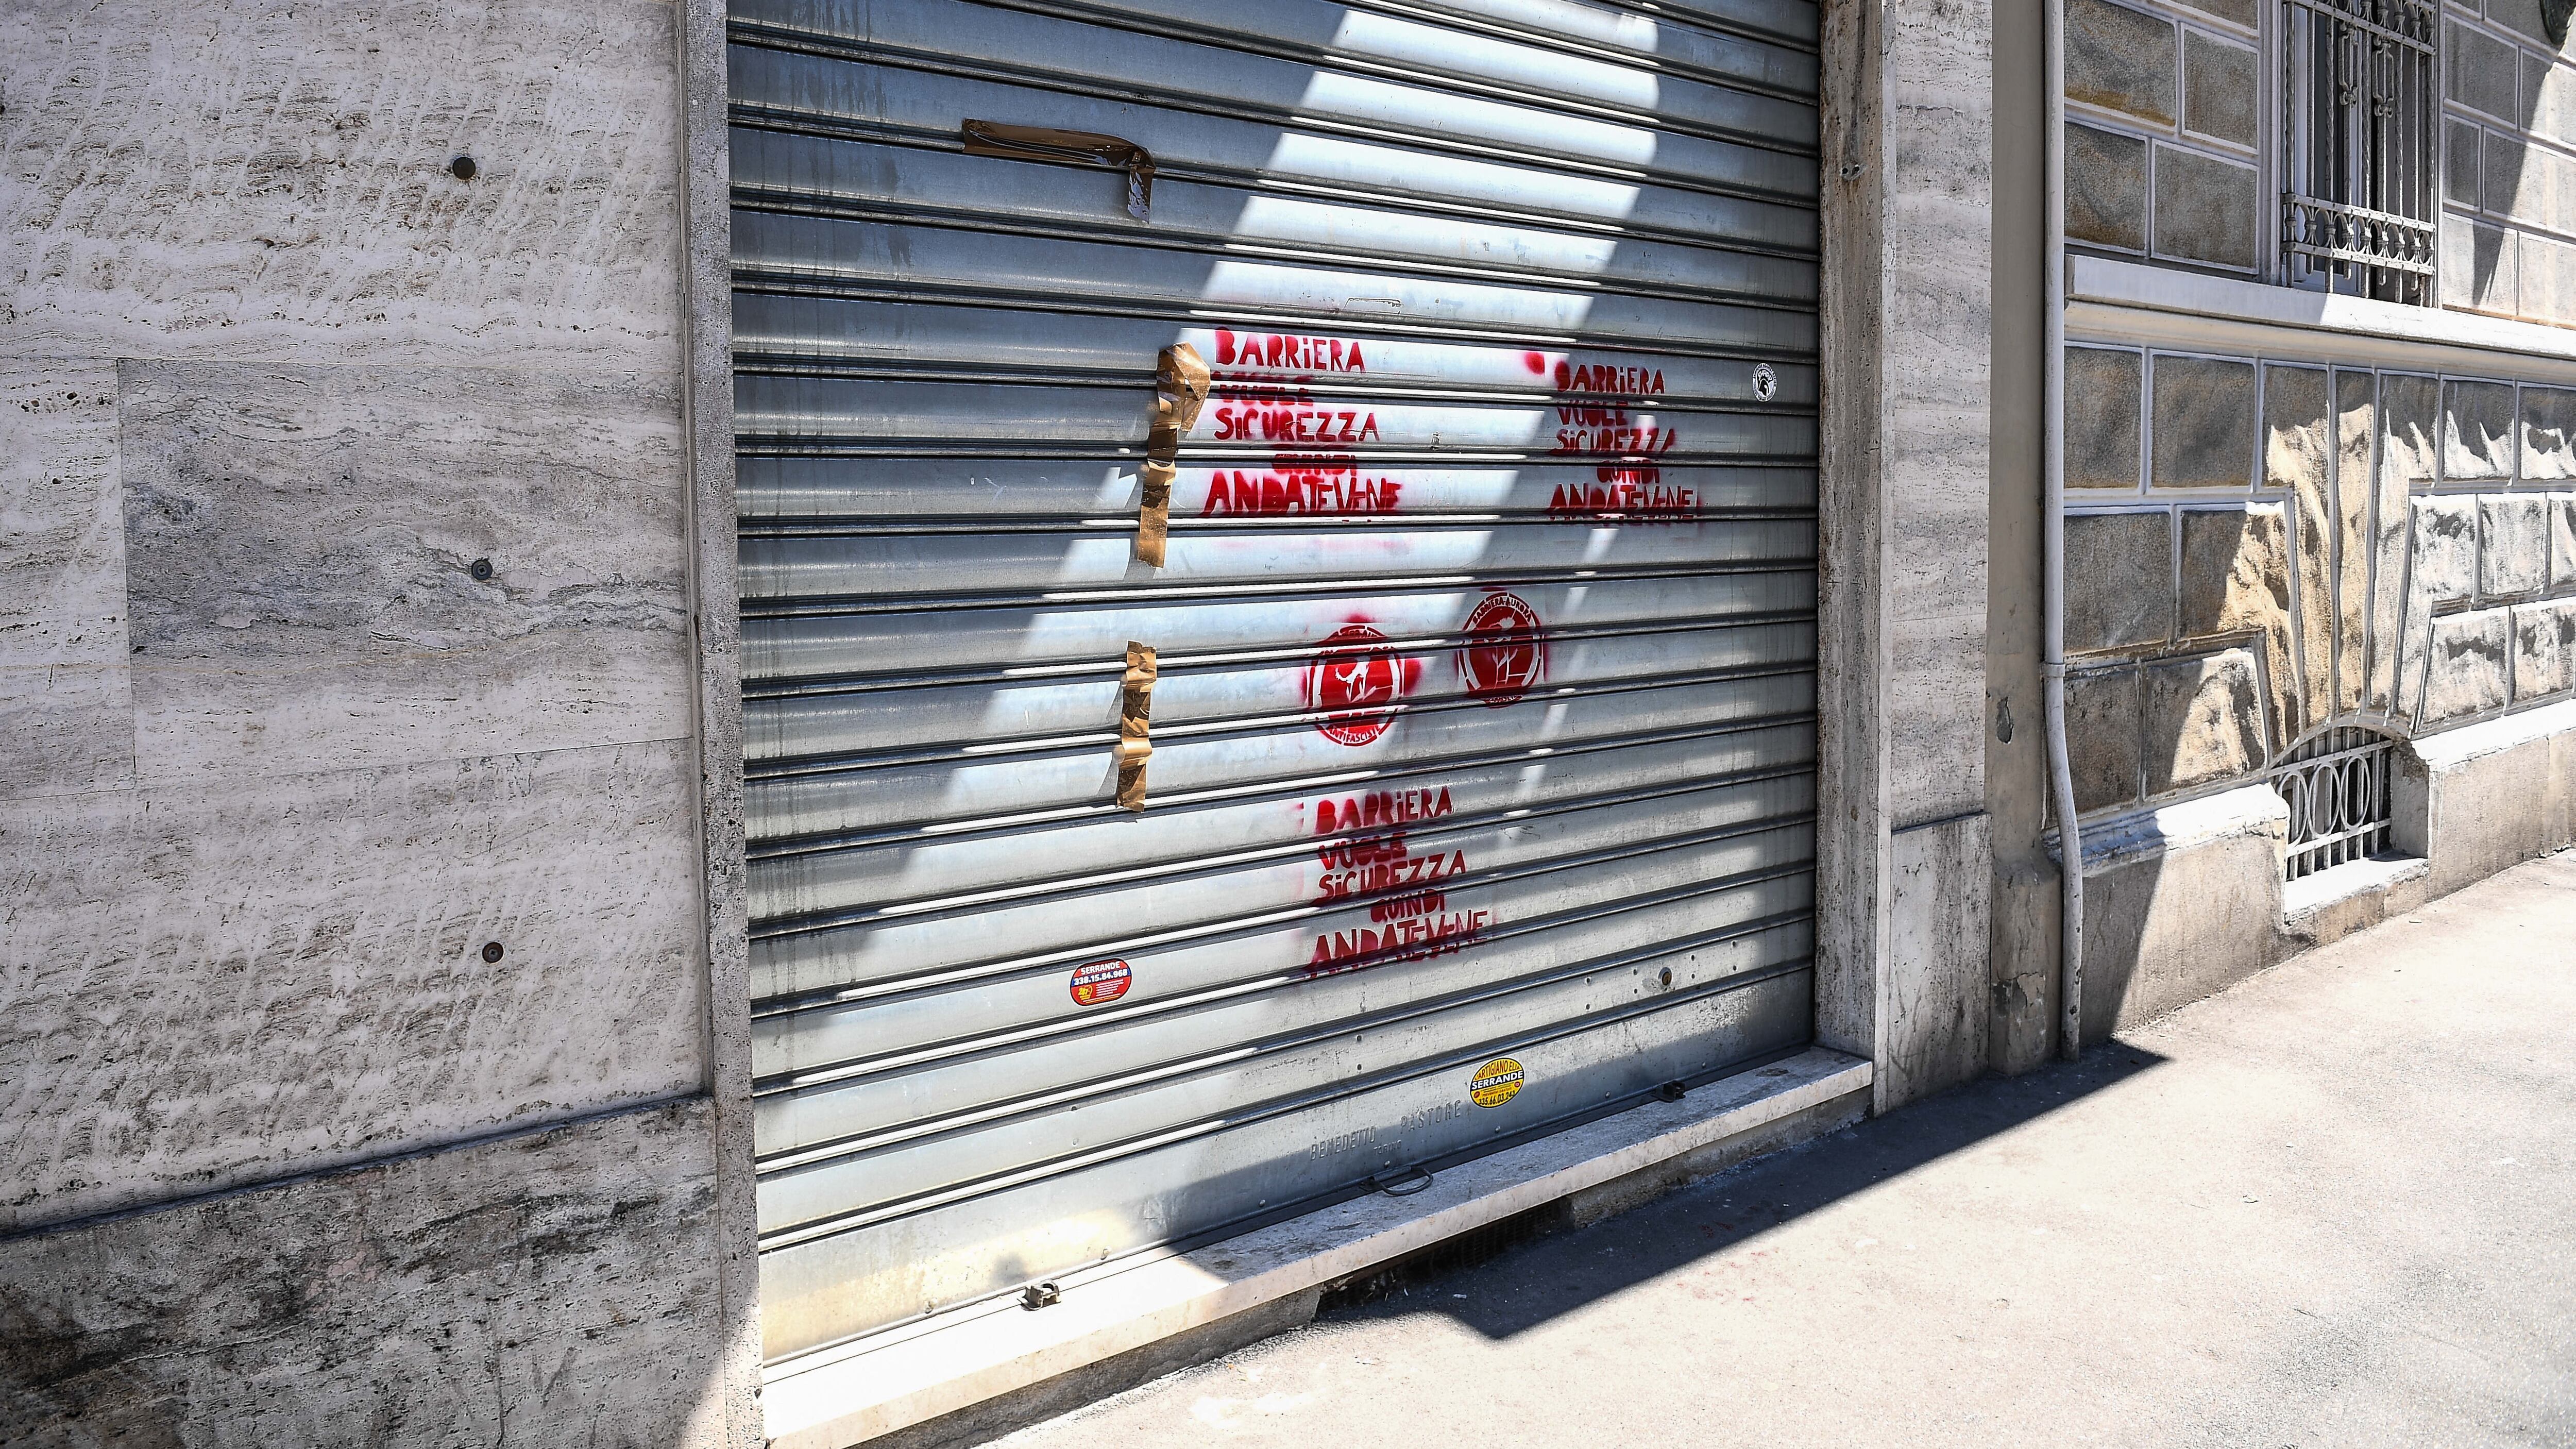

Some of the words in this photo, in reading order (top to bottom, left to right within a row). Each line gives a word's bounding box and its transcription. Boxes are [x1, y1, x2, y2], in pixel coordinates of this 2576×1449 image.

[1080, 961, 1121, 975] SERRANDE
[1074, 969, 1128, 986] 338.15.84.968
[1509, 1062, 1520, 1071] ELIA
[1471, 1071, 1523, 1090] SERRANDE
[1310, 1125, 1377, 1160] BENEDETTO
[1400, 1100, 1461, 1134] PASTORE
[1373, 1139, 1402, 1156] TORINO
